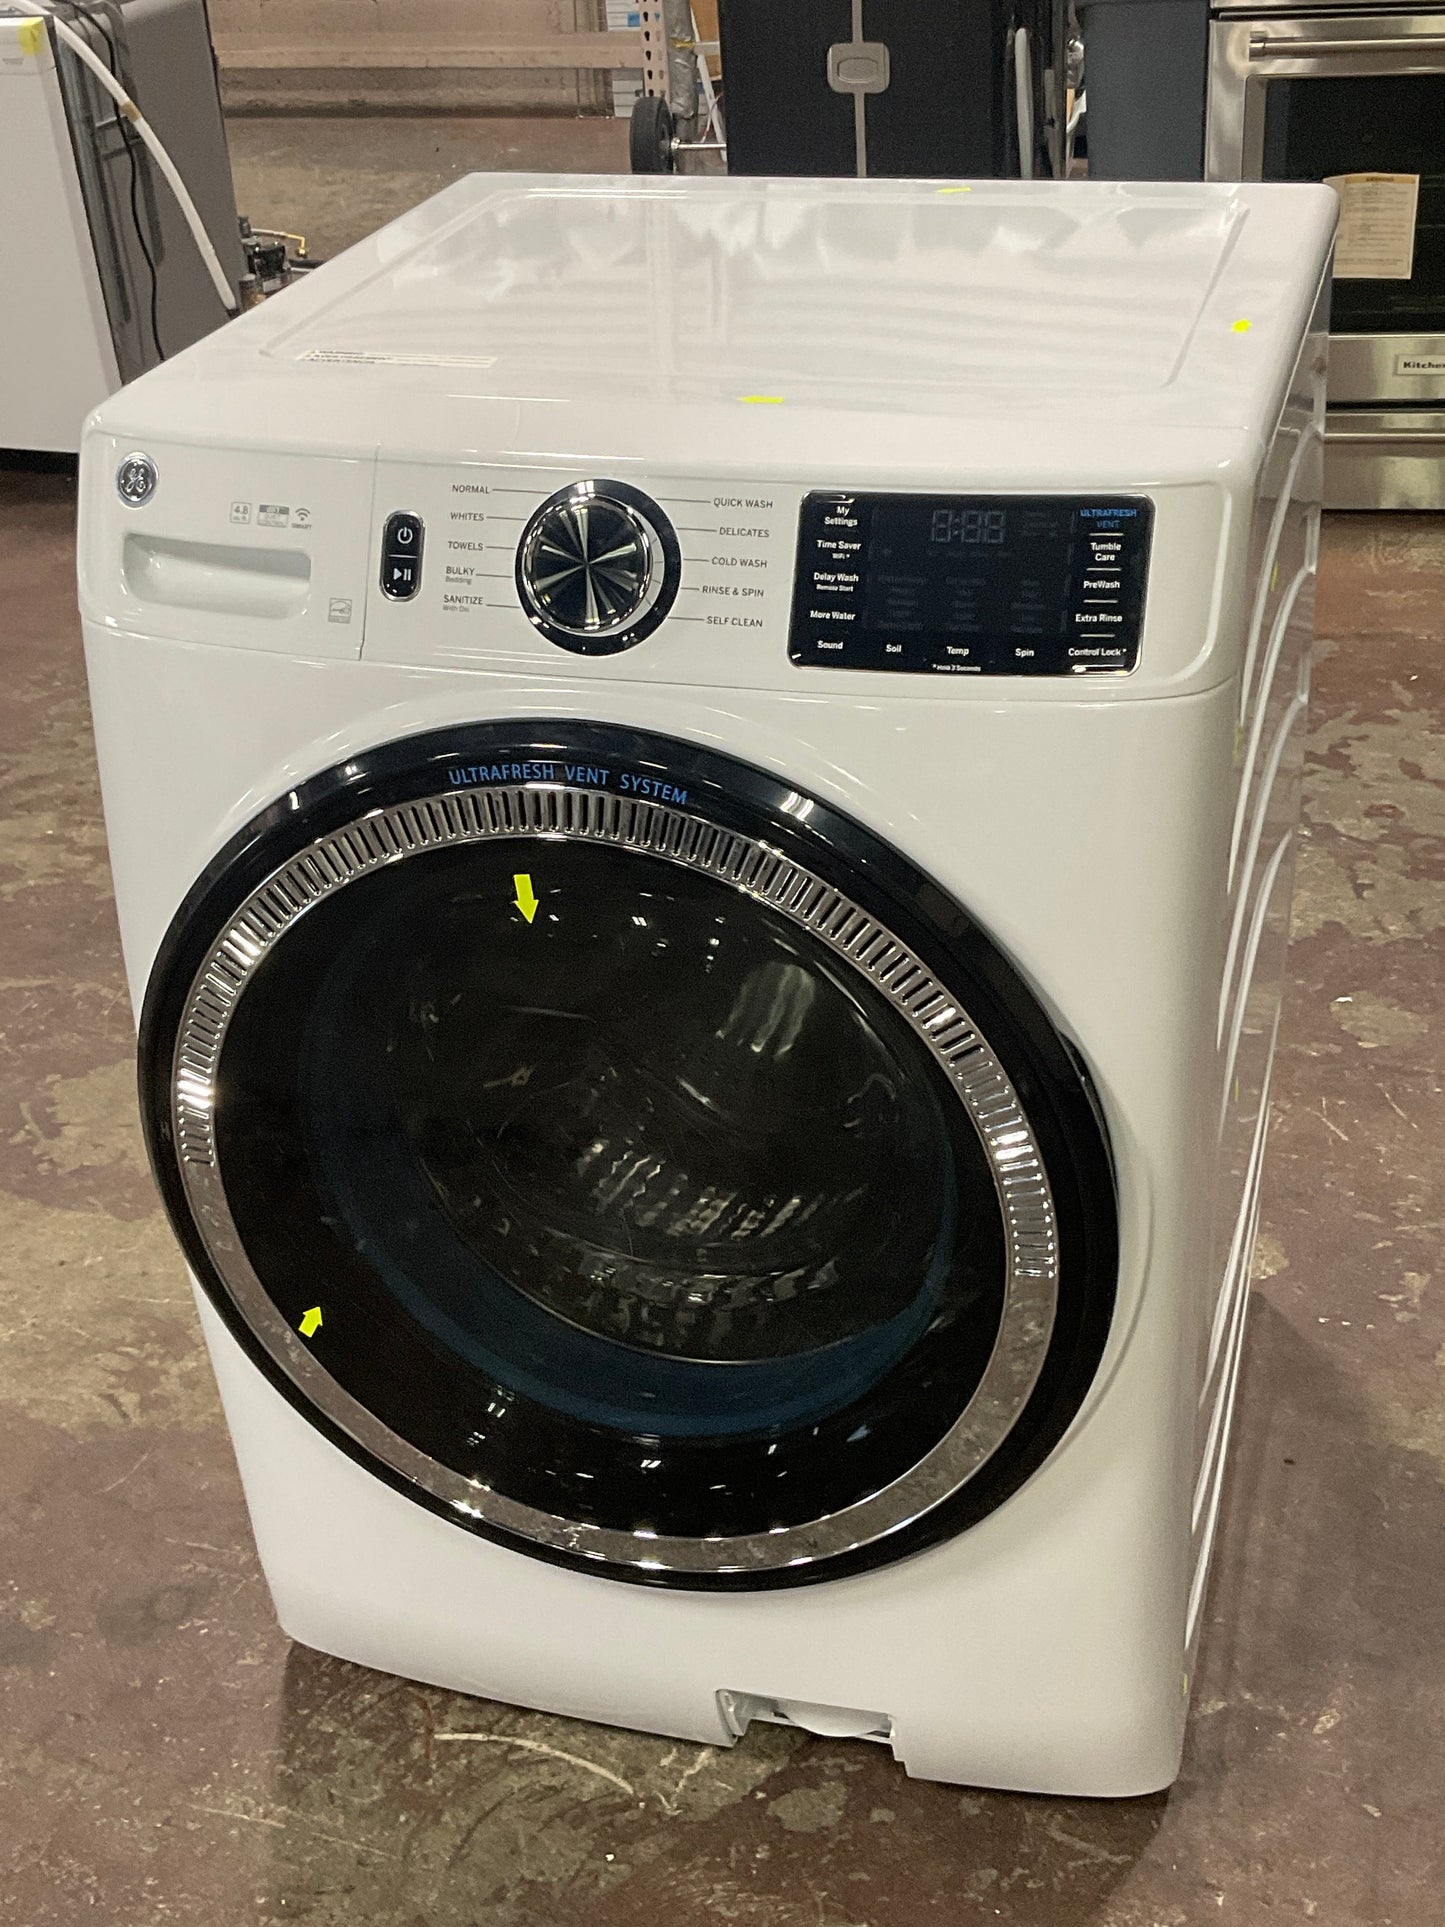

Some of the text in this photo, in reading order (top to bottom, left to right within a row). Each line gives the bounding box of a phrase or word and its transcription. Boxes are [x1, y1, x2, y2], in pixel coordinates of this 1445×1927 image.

[452, 485, 490, 495] NORMAL
[713, 498, 773, 509] QUICK WASH
[837, 506, 850, 516] My
[1080, 508, 1137, 518] ULTRAFRESH
[450, 512, 485, 522] WHITES
[824, 517, 858, 527] Settings
[1096, 520, 1121, 528] VENT
[719, 527, 770, 538] DELICATES
[448, 541, 484, 551] TOWELS
[816, 540, 862, 550] Time Saver
[1090, 542, 1122, 551] Tumble
[711, 556, 768, 568] COLD WASH
[1095, 553, 1116, 561] Care
[446, 566, 475, 575] BULKY
[813, 572, 859, 582] Delay Wash
[1083, 581, 1121, 589] PreWash
[702, 585, 764, 597] RINSE & SPIN
[443, 594, 484, 605] SANITIZE
[810, 610, 856, 620] More Water
[1075, 614, 1123, 622] Extra Rinse
[707, 615, 763, 627] SELF CLEAN
[817, 641, 843, 649] Sound
[886, 645, 901, 653] Soil
[946, 646, 969, 656] Temp
[1015, 648, 1034, 657] Spin
[1068, 648, 1121, 656] Control Lock
[450, 763, 688, 805] ULTRAFRESH VENT SYSTEM
